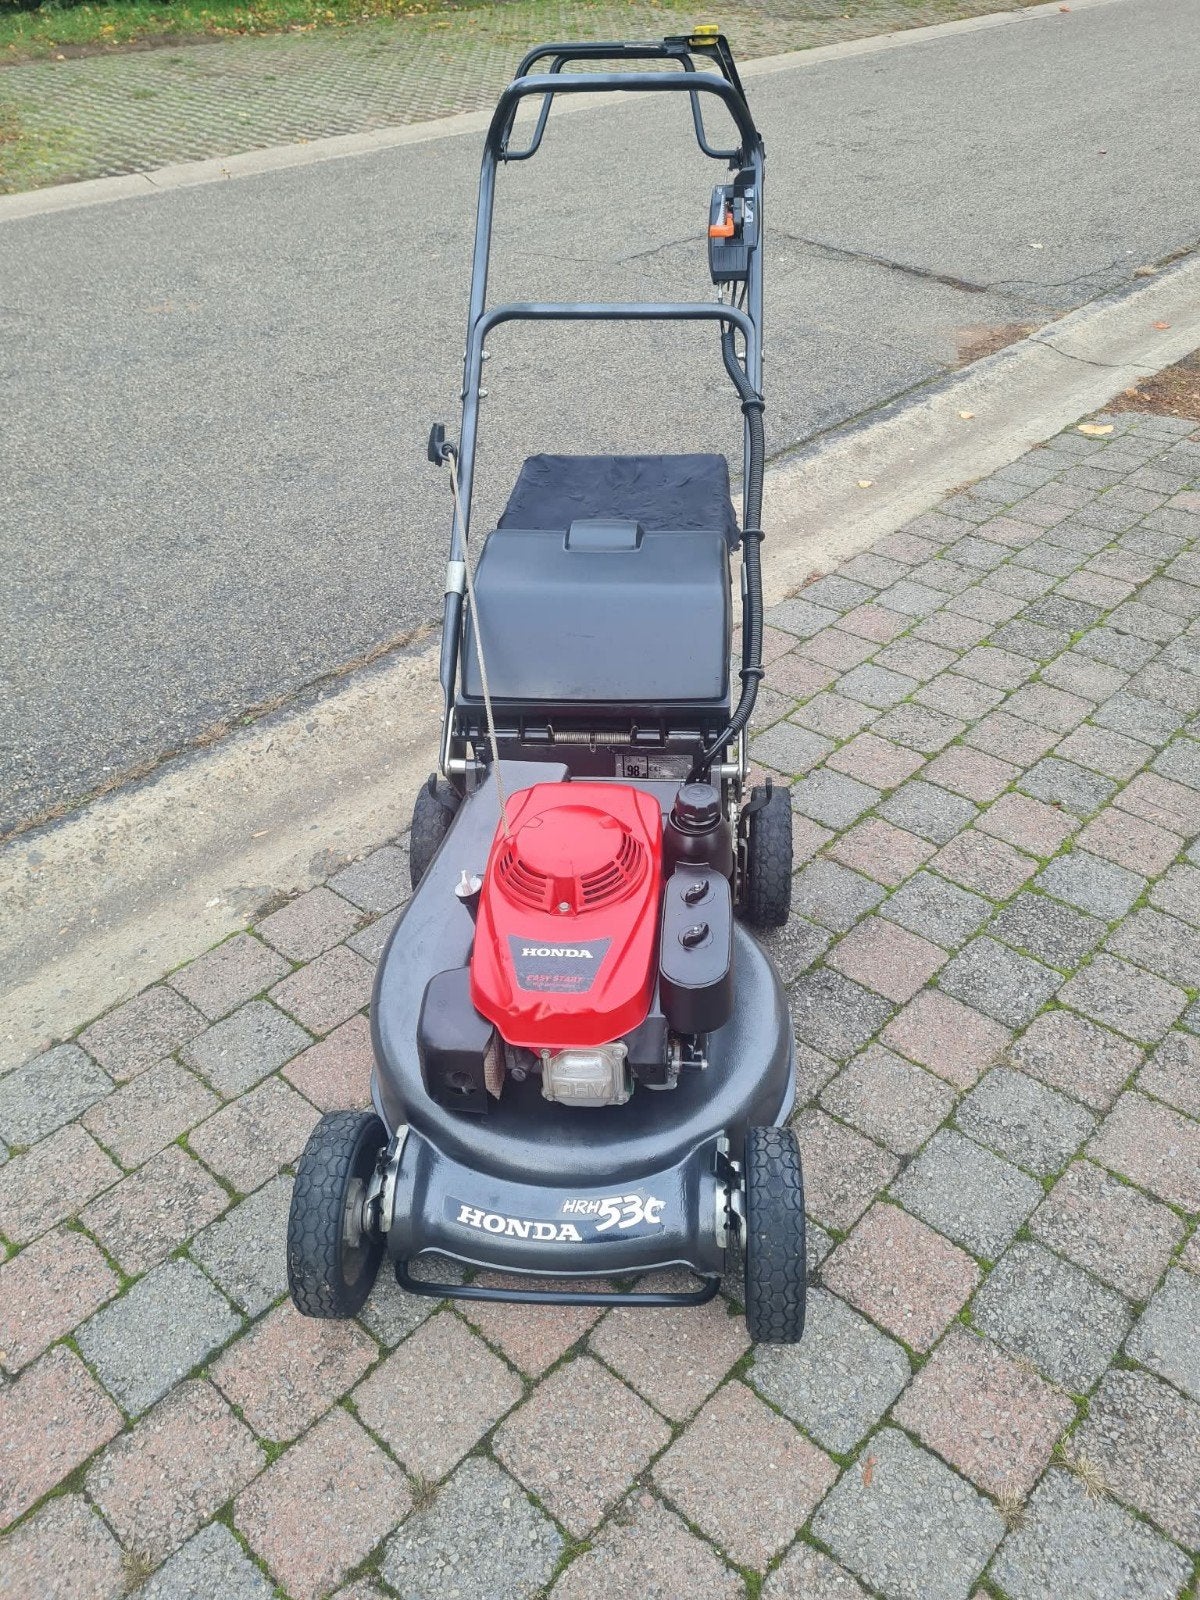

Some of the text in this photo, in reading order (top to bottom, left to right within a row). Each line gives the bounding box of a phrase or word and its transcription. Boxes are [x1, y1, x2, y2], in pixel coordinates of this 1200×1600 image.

[627, 765, 640, 777] 98
[521, 948, 593, 958] HONDA
[527, 974, 583, 983] EASY START
[456, 1205, 583, 1242] HONDA
